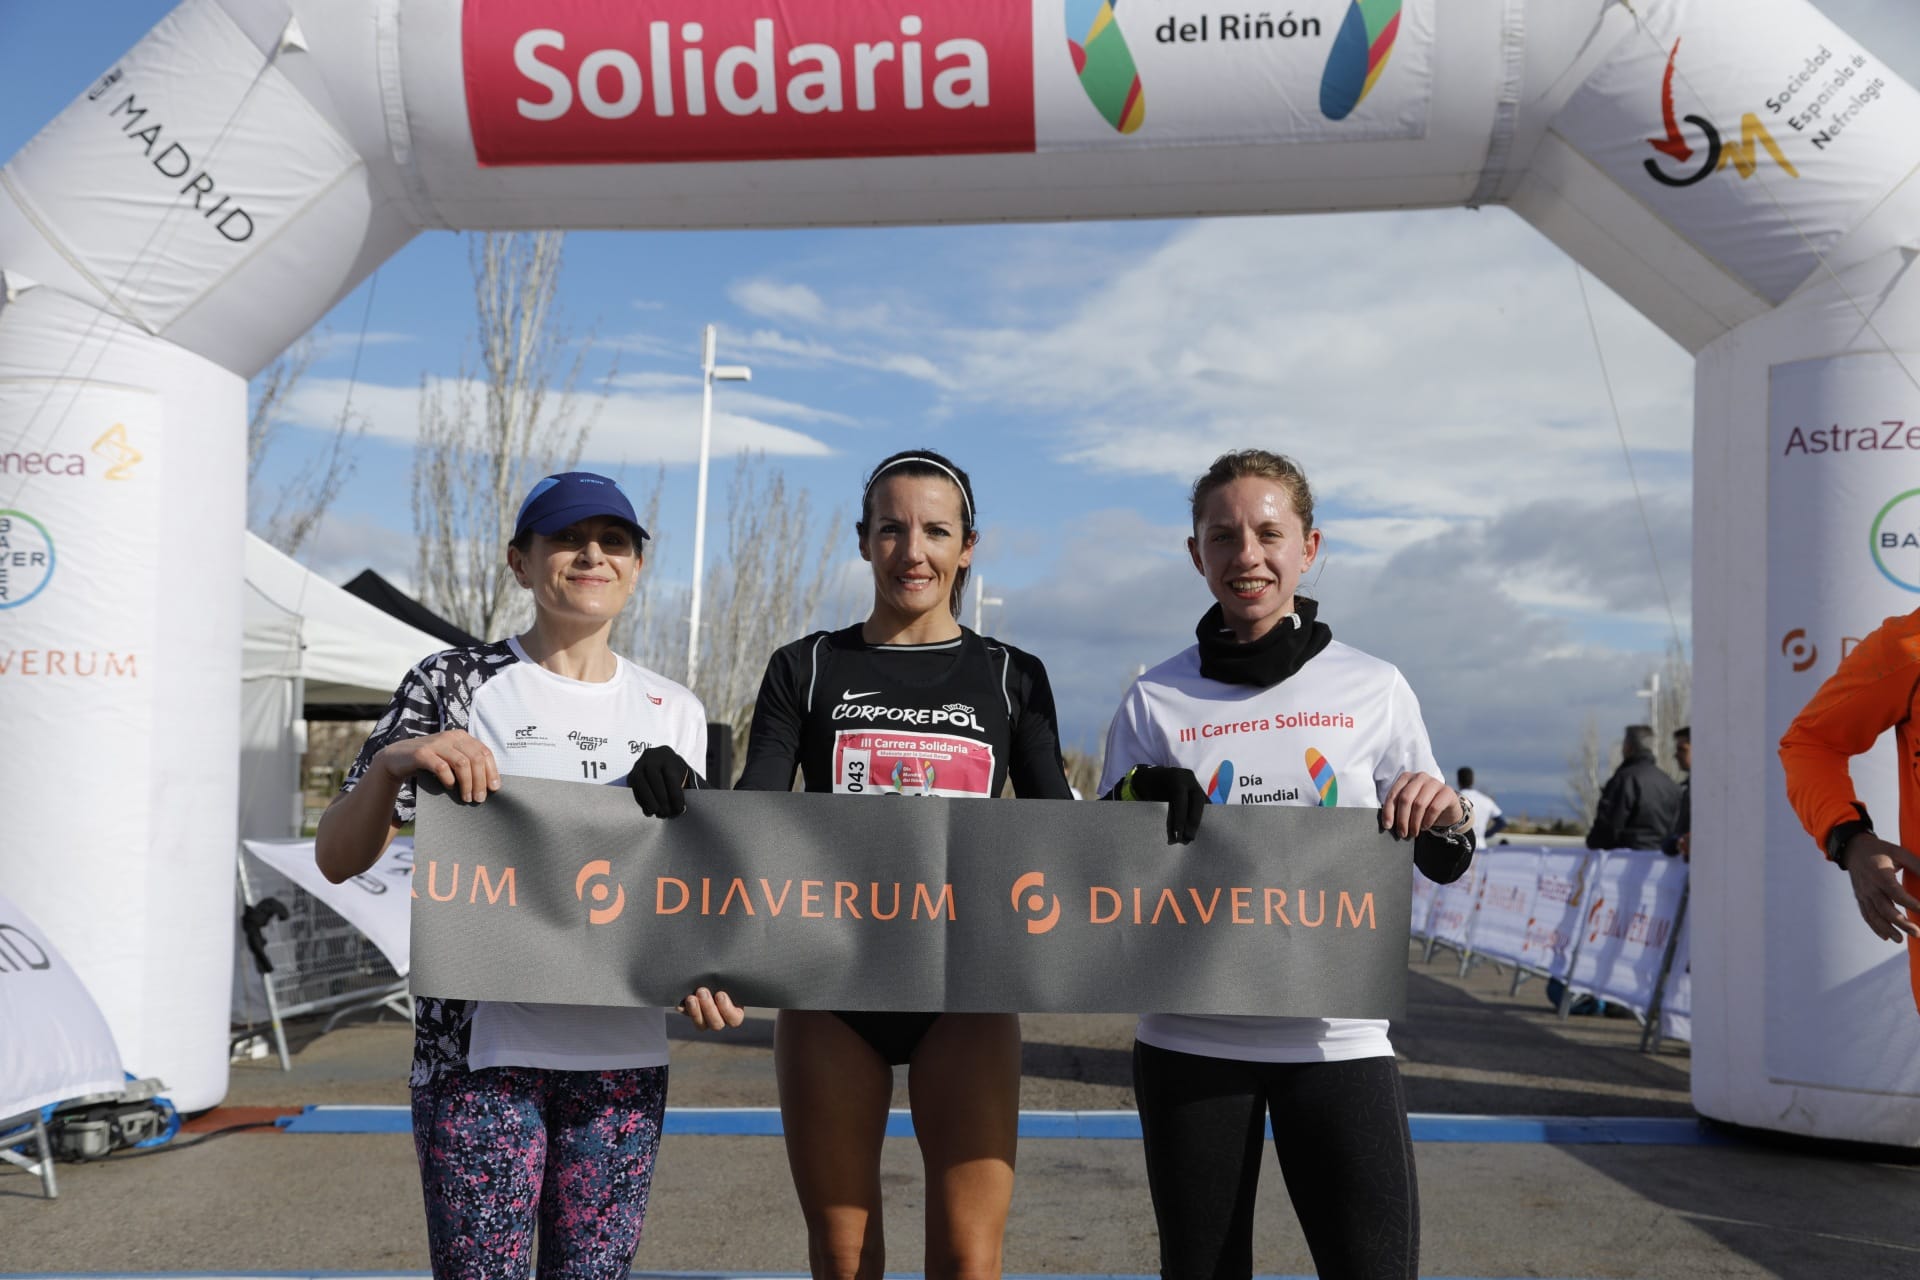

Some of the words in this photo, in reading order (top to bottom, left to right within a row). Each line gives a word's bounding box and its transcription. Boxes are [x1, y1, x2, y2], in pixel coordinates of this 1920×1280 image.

[1155, 14, 1208, 43] del
[1220, 11, 1321, 41] Riñón
[513, 15, 990, 121] Solidaria
[1765, 44, 1832, 114] Sociedad
[1788, 68, 1855, 132] Española
[109, 93, 254, 242] MADRID
[1784, 420, 1920, 457] AstraZe
[0, 452, 85, 476] neca
[832, 703, 985, 733] CORPOREPOL
[1180, 727, 1196, 742] III
[1201, 719, 1270, 738] Carrera
[1275, 712, 1354, 730] Solidaria
[861, 738, 872, 748] III
[875, 738, 917, 750] Carrera
[920, 739, 968, 754] Solidaria
[848, 761, 865, 793] 043
[1239, 774, 1263, 787] Día
[1241, 788, 1299, 805] Mundial
[411, 861, 517, 907] UM
[655, 877, 957, 921] DIAVERUM
[1089, 886, 1377, 930] DIAVERUM
